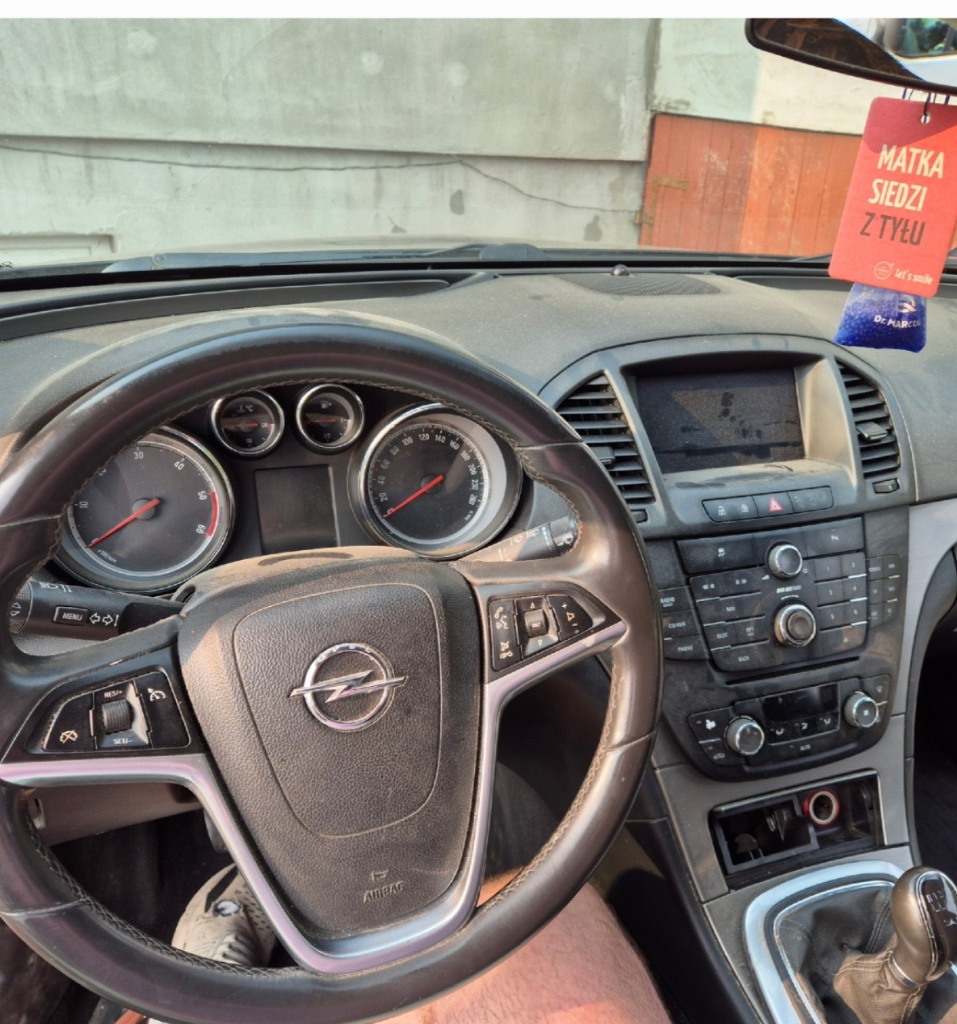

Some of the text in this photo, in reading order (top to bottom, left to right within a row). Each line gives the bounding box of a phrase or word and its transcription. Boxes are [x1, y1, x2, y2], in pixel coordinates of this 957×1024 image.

[877, 144, 945, 179] MATKA
[868, 178, 928, 212] SIEDZI
[860, 212, 926, 246] Z TYŁU
[874, 315, 886, 325] Dr.
[401, 436, 413, 446] 100
[418, 433, 431, 441] 120
[434, 433, 446, 443] 140
[133, 451, 144, 460] 30
[173, 461, 185, 471] 40
[196, 524, 206, 534] 60
[62, 612, 83, 621] MENU
